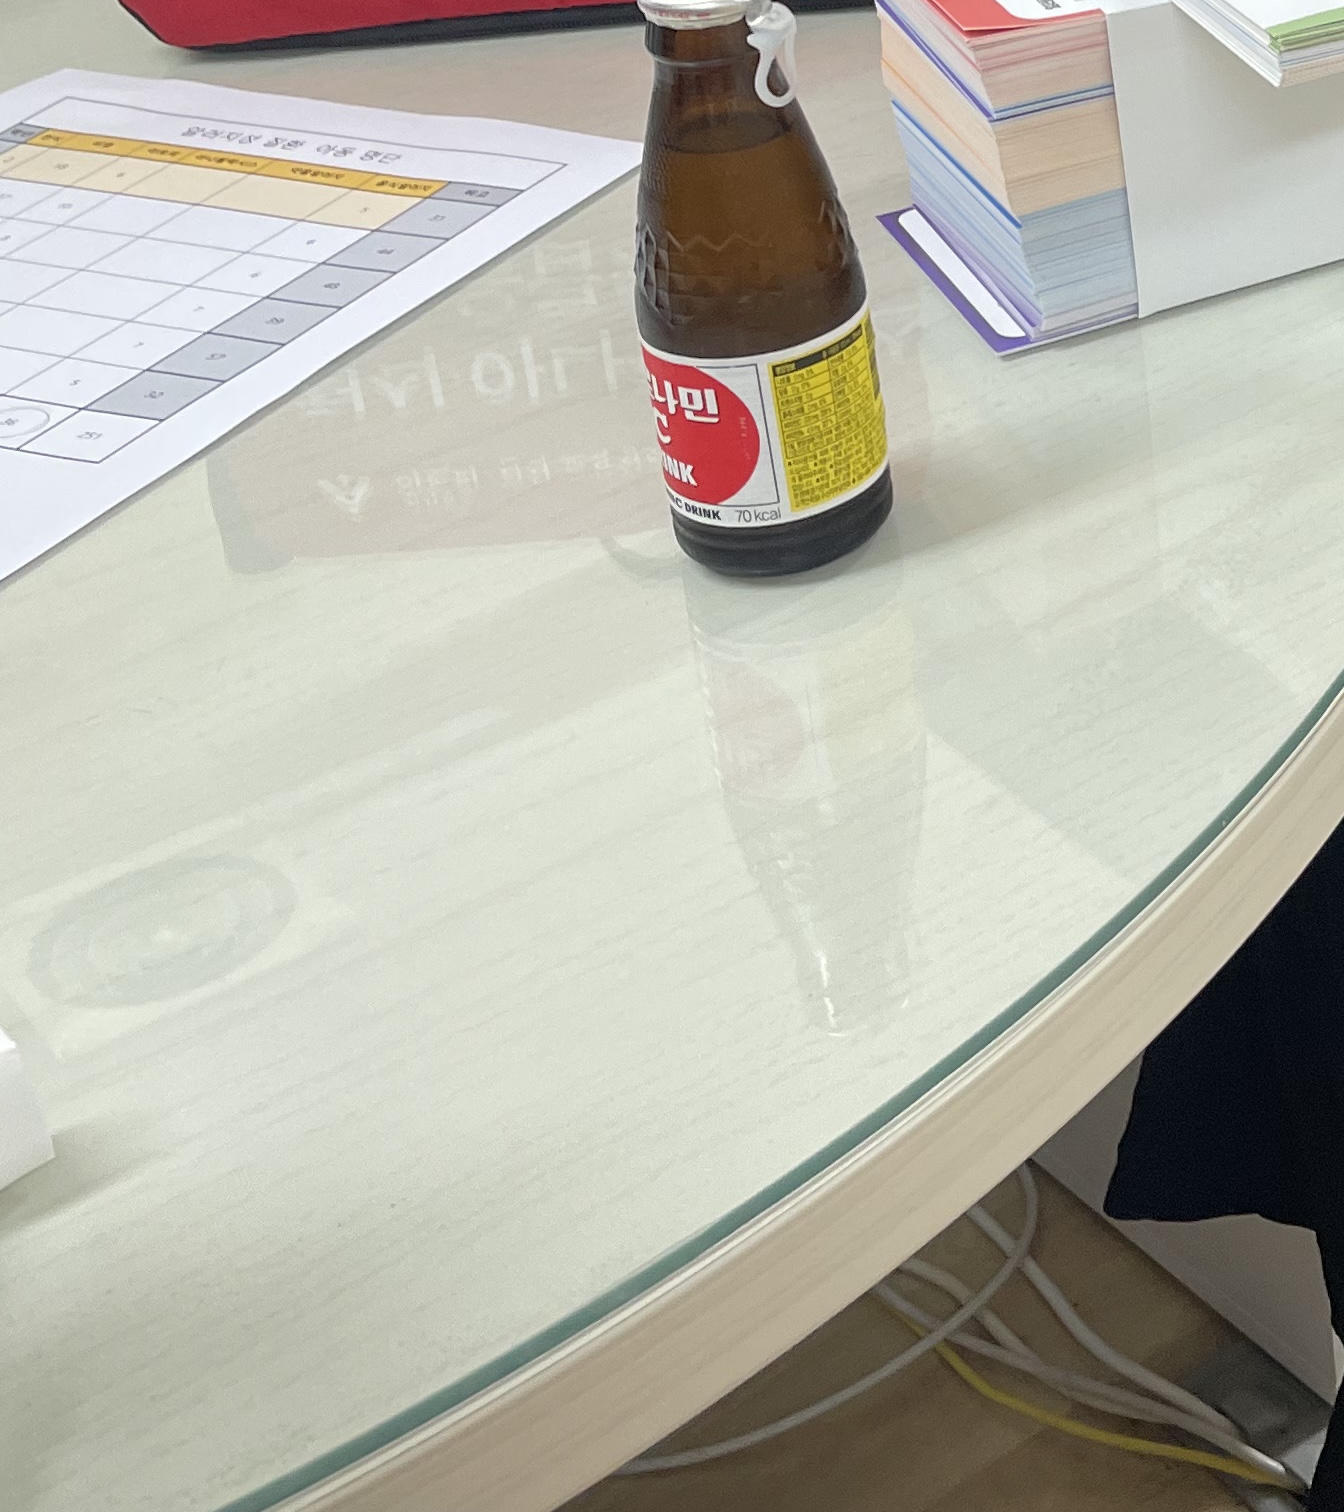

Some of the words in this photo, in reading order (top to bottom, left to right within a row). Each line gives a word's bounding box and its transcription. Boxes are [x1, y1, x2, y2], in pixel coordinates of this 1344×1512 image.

[264, 136, 308, 152] 질환
[317, 143, 357, 159] 아동
[360, 149, 403, 165] 명단
[647, 372, 721, 424] 나민
[653, 405, 672, 445] C
[684, 501, 722, 521] DRINK
